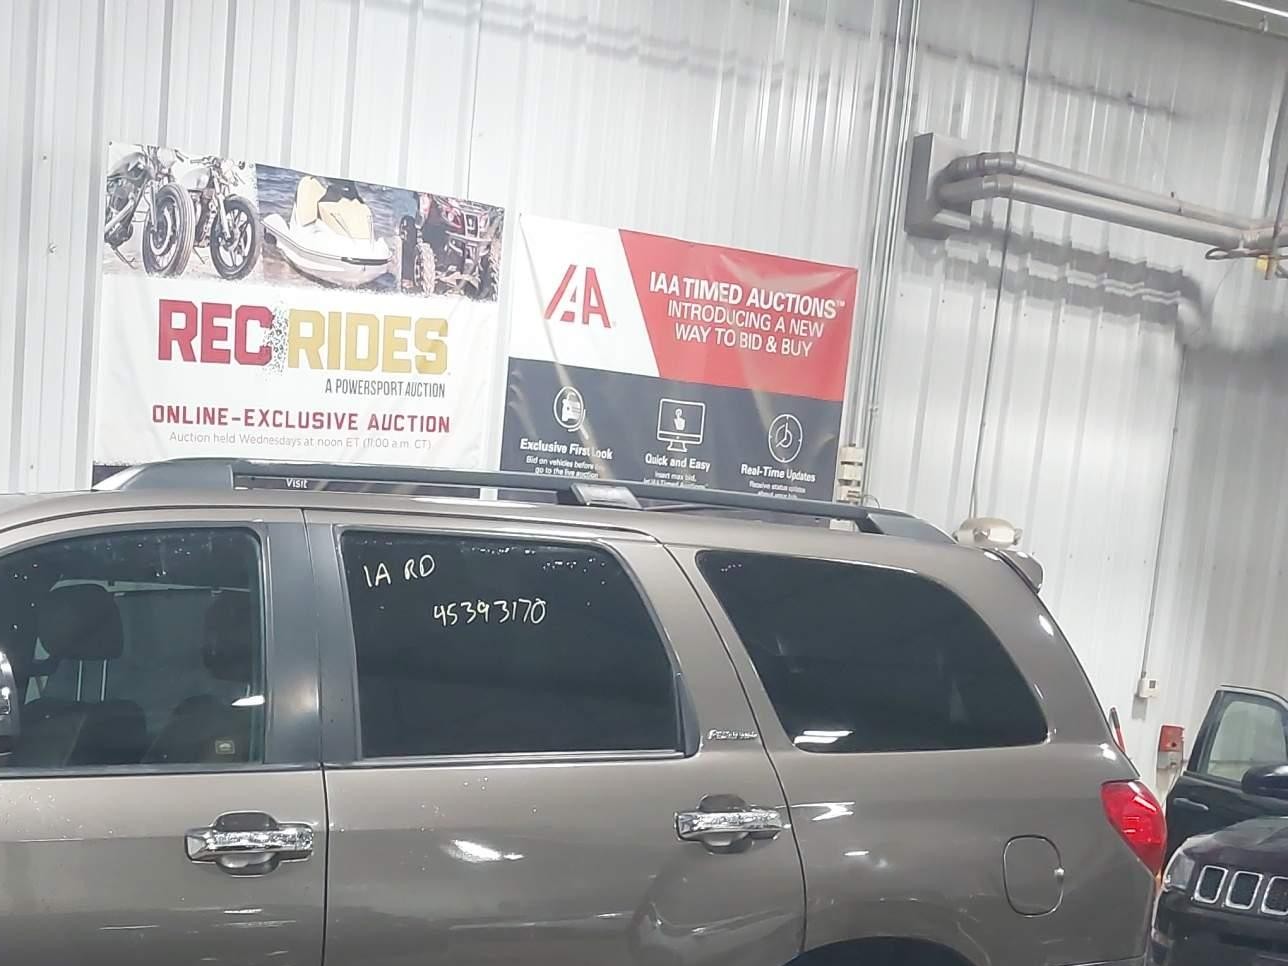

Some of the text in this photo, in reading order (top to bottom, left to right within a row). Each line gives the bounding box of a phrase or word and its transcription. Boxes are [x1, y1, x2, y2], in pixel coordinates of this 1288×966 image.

[650, 272, 680, 296] IAA
[684, 279, 743, 304] TIMED
[668, 300, 824, 338] INTRODUCING A NEW
[159, 299, 449, 375] REC RIDES
[676, 322, 813, 357] WAY TO BID & BUY
[325, 378, 445, 398] A POWERSPORT AUCTION
[152, 404, 450, 433] ONLINE-EXCLUSIVE AUCTION
[169, 432, 211, 443] Auction
[213, 433, 236, 444] held
[239, 434, 301, 448] Wednesdays
[303, 438, 314, 447] at
[317, 438, 343, 447] noon
[346, 438, 360, 447] ET
[520, 438, 567, 454] Exclusive
[569, 443, 590, 457] First
[645, 453, 710, 472] Quick and Easy
[741, 464, 815, 482] Real-Time Updates
[286, 477, 307, 488] Visit
[433, 598, 546, 626] 45393170
